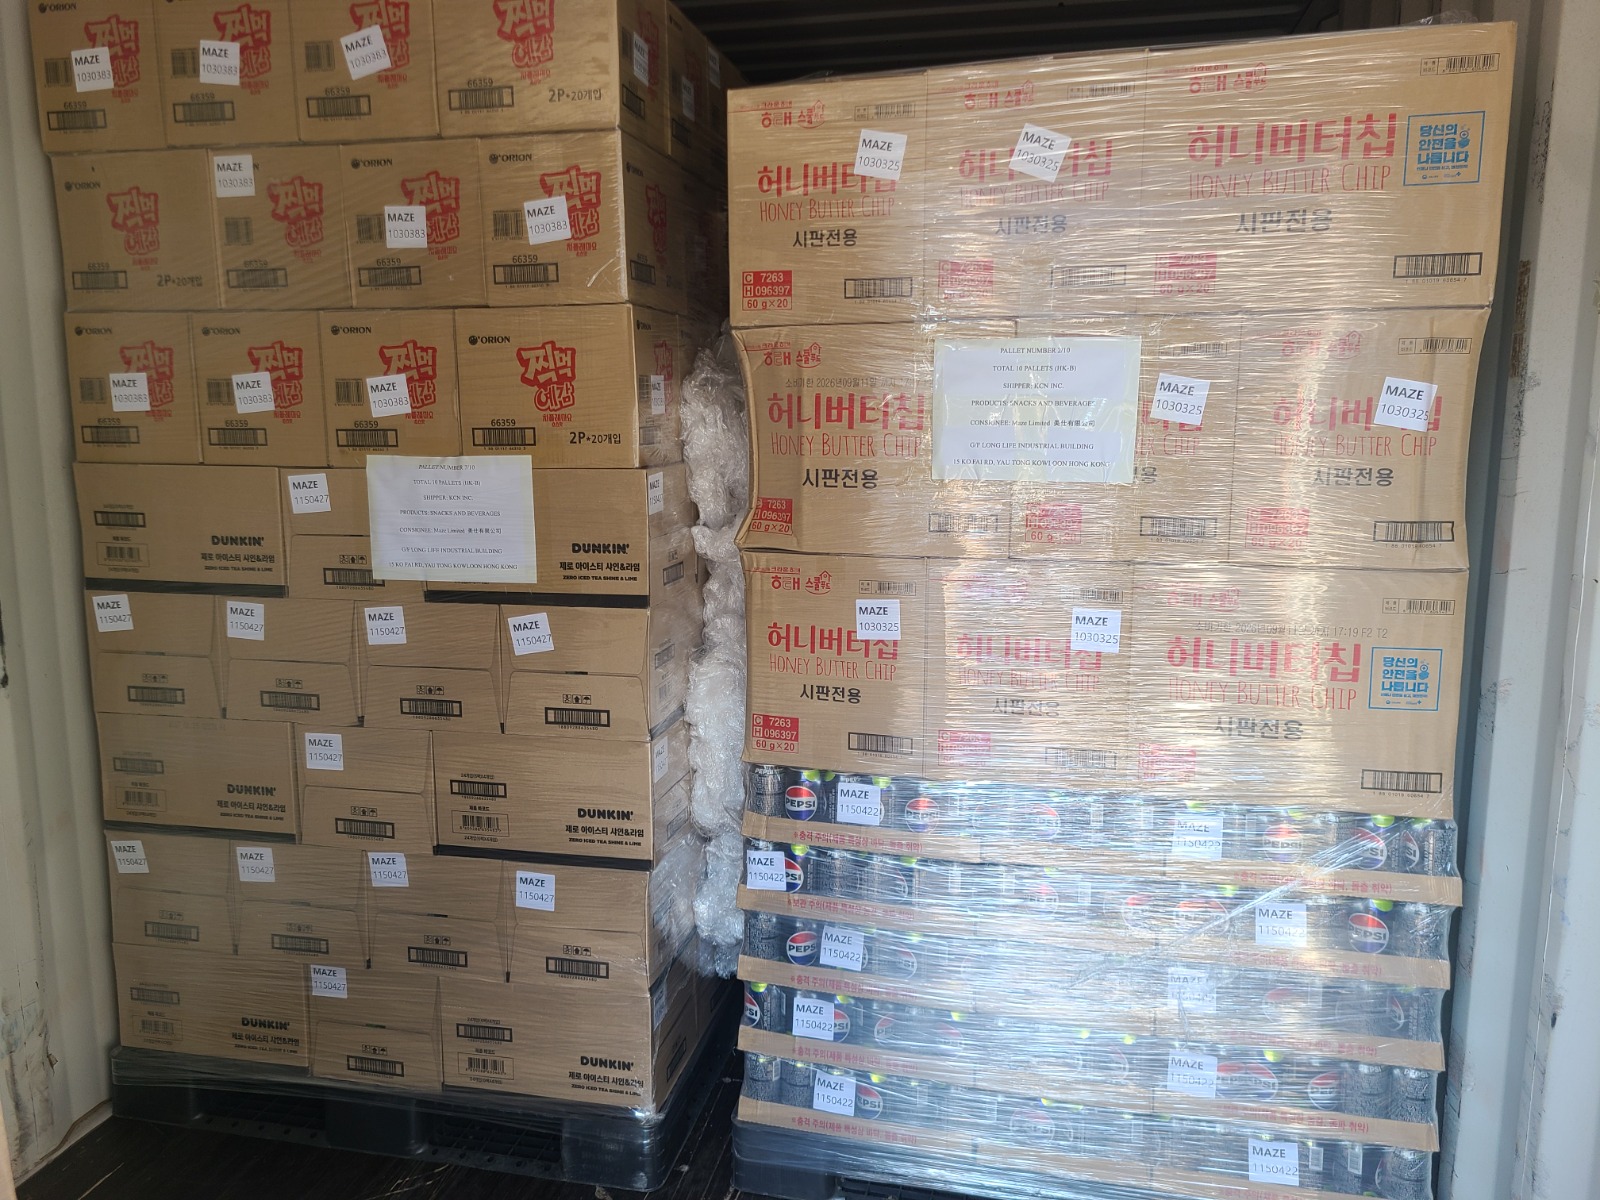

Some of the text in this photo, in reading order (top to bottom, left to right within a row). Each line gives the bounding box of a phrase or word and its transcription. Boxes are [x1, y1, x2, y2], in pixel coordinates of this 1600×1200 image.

[345, 35, 373, 52] MAZE
[202, 46, 230, 58] MAZE
[74, 55, 101, 65] MAZE
[350, 50, 388, 69] 1030383
[201, 63, 238, 76] 1030383
[77, 70, 112, 82] 1030383
[467, 78, 493, 88] 66359
[1420, 123, 1458, 137] 당신의
[861, 138, 893, 152] MAZE
[1022, 131, 1057, 151] MAZE
[1188, 113, 1397, 167] 허니버터칩
[501, 154, 532, 162] ORION
[859, 155, 901, 172] 1030325
[1016, 149, 1059, 172] 1030325
[217, 162, 243, 172] MAZE
[218, 177, 253, 188] 1030383
[1189, 163, 1391, 200] HONEY BUTTER CHIP
[527, 205, 555, 218] MAZE
[759, 195, 895, 223] HONEY BUTTER CHIP
[388, 213, 415, 222] MAZE
[529, 220, 568, 235] 1030383
[388, 229, 426, 239] 1030383
[792, 228, 858, 249] 시판전용
[512, 255, 538, 263] 66359
[760, 272, 784, 283] 7263
[755, 285, 790, 297] 096397
[747, 299, 760, 309] 60
[342, 326, 372, 334] ORION
[480, 336, 511, 344] ORION
[517, 342, 576, 386] 찍먹
[112, 379, 137, 388] MAZE
[236, 380, 262, 391] MAZE
[370, 382, 397, 393] MAZE
[1003, 382, 1033, 390] SHIPPER:
[1050, 382, 1064, 390] INC.
[1159, 381, 1195, 396] MAZE
[534, 382, 575, 411] 예감
[1385, 384, 1424, 401] MAZE
[238, 394, 273, 406] 1030383
[372, 396, 409, 409] 1030383
[767, 393, 925, 430] 허니버터칩
[1156, 398, 1203, 416] 1030325
[1381, 403, 1429, 421] 1030325
[354, 420, 379, 429] 66359
[490, 419, 516, 427] 66359
[771, 433, 922, 457] HONEY BUTTER CHIP
[1090, 460, 1111, 468] KONG
[802, 468, 879, 489] 시판전용
[292, 480, 319, 490] MAZE
[294, 494, 329, 505] 1150427
[572, 543, 630, 555] DUNKIN'
[560, 562, 574, 571] 제로
[575, 562, 603, 572] 아이스티
[97, 601, 122, 611] MAZE
[230, 606, 255, 617] MAZE
[858, 606, 889, 616] MAZE
[99, 614, 133, 624] 1150427
[368, 612, 395, 622] MAZE
[1075, 615, 1109, 627] MAZE
[230, 621, 264, 633] 1150427
[370, 626, 405, 636] 1150427
[513, 621, 540, 632] MAZE
[858, 621, 899, 632] 1030325
[1333, 626, 1388, 639] 17:19 F2 T2
[515, 634, 552, 648] 1150427
[1074, 632, 1119, 645] 1030325
[1167, 636, 1361, 683] 허니버터칩
[769, 653, 897, 681] HONEY BUTTER CHIP
[800, 684, 862, 705] 시판전용
[308, 738, 334, 748] MAZE
[309, 752, 343, 762] 1150427
[840, 789, 870, 800] MAZE
[785, 798, 817, 809] PEPSI
[578, 808, 634, 821] DUNKIN'
[839, 803, 879, 817] 1150422
[115, 845, 136, 854] MAZE
[118, 858, 147, 867] 1150427
[240, 852, 265, 861] MAZE
[371, 857, 397, 866] MAZE
[747, 856, 775, 867] MAZE
[241, 865, 274, 875] 1150427
[373, 870, 407, 880] 1150427
[519, 876, 546, 888] MAZE
[748, 871, 785, 883] 1150422
[519, 890, 555, 903] 1150427
[1258, 908, 1293, 920] MAZE
[824, 932, 853, 945] MAZE
[822, 947, 861, 962] 1150422
[313, 968, 338, 978] MAZE
[314, 980, 347, 992] 1150427
[795, 1004, 824, 1016] MAZE
[794, 1018, 833, 1032] 1150422
[1171, 1057, 1204, 1070] MAZE
[817, 1078, 845, 1092] MAZE
[816, 1093, 854, 1108] 1150422
[1252, 1145, 1287, 1159] MAZE
[1252, 1163, 1299, 1177] 1150422
